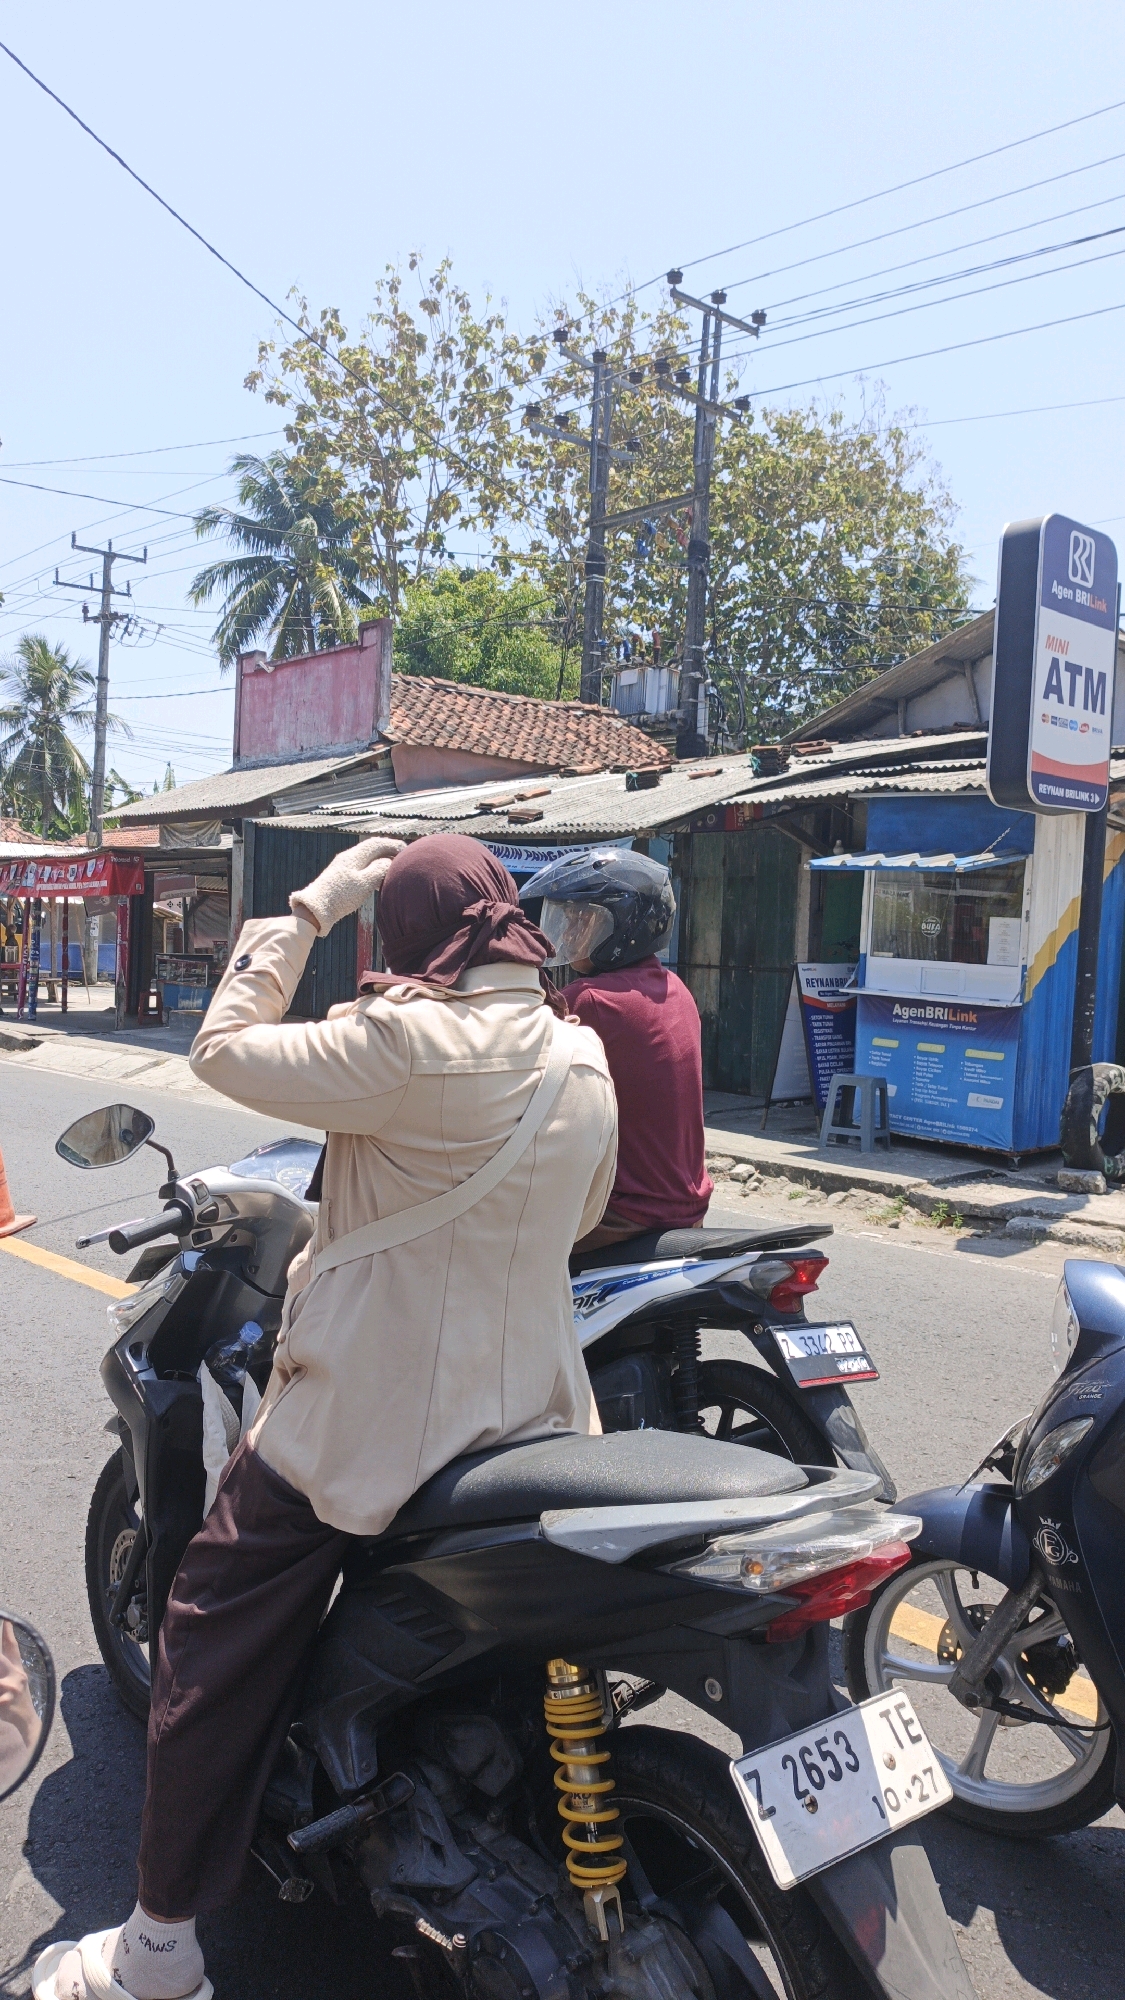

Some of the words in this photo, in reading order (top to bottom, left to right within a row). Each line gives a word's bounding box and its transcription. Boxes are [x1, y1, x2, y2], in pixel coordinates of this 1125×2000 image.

[1051, 580, 1073, 600] Agen
[1075, 588, 1107, 613] BRILink
[1045, 634, 1069, 656] MINI
[1043, 656, 1106, 715] ATM
[1038, 783, 1064, 798] REYNAN
[1090, 793, 1095, 803] 3
[893, 1003, 978, 1024] AgenBRILink
[782, 1338, 796, 1358] Z
[799, 1332, 837, 1357] 3342
[837, 1331, 855, 1353] PP
[1047, 1574, 1082, 1594] YAMAHA
[743, 1769, 776, 1821] Z
[781, 1730, 860, 1801] 2653
[879, 1701, 923, 1750] TE
